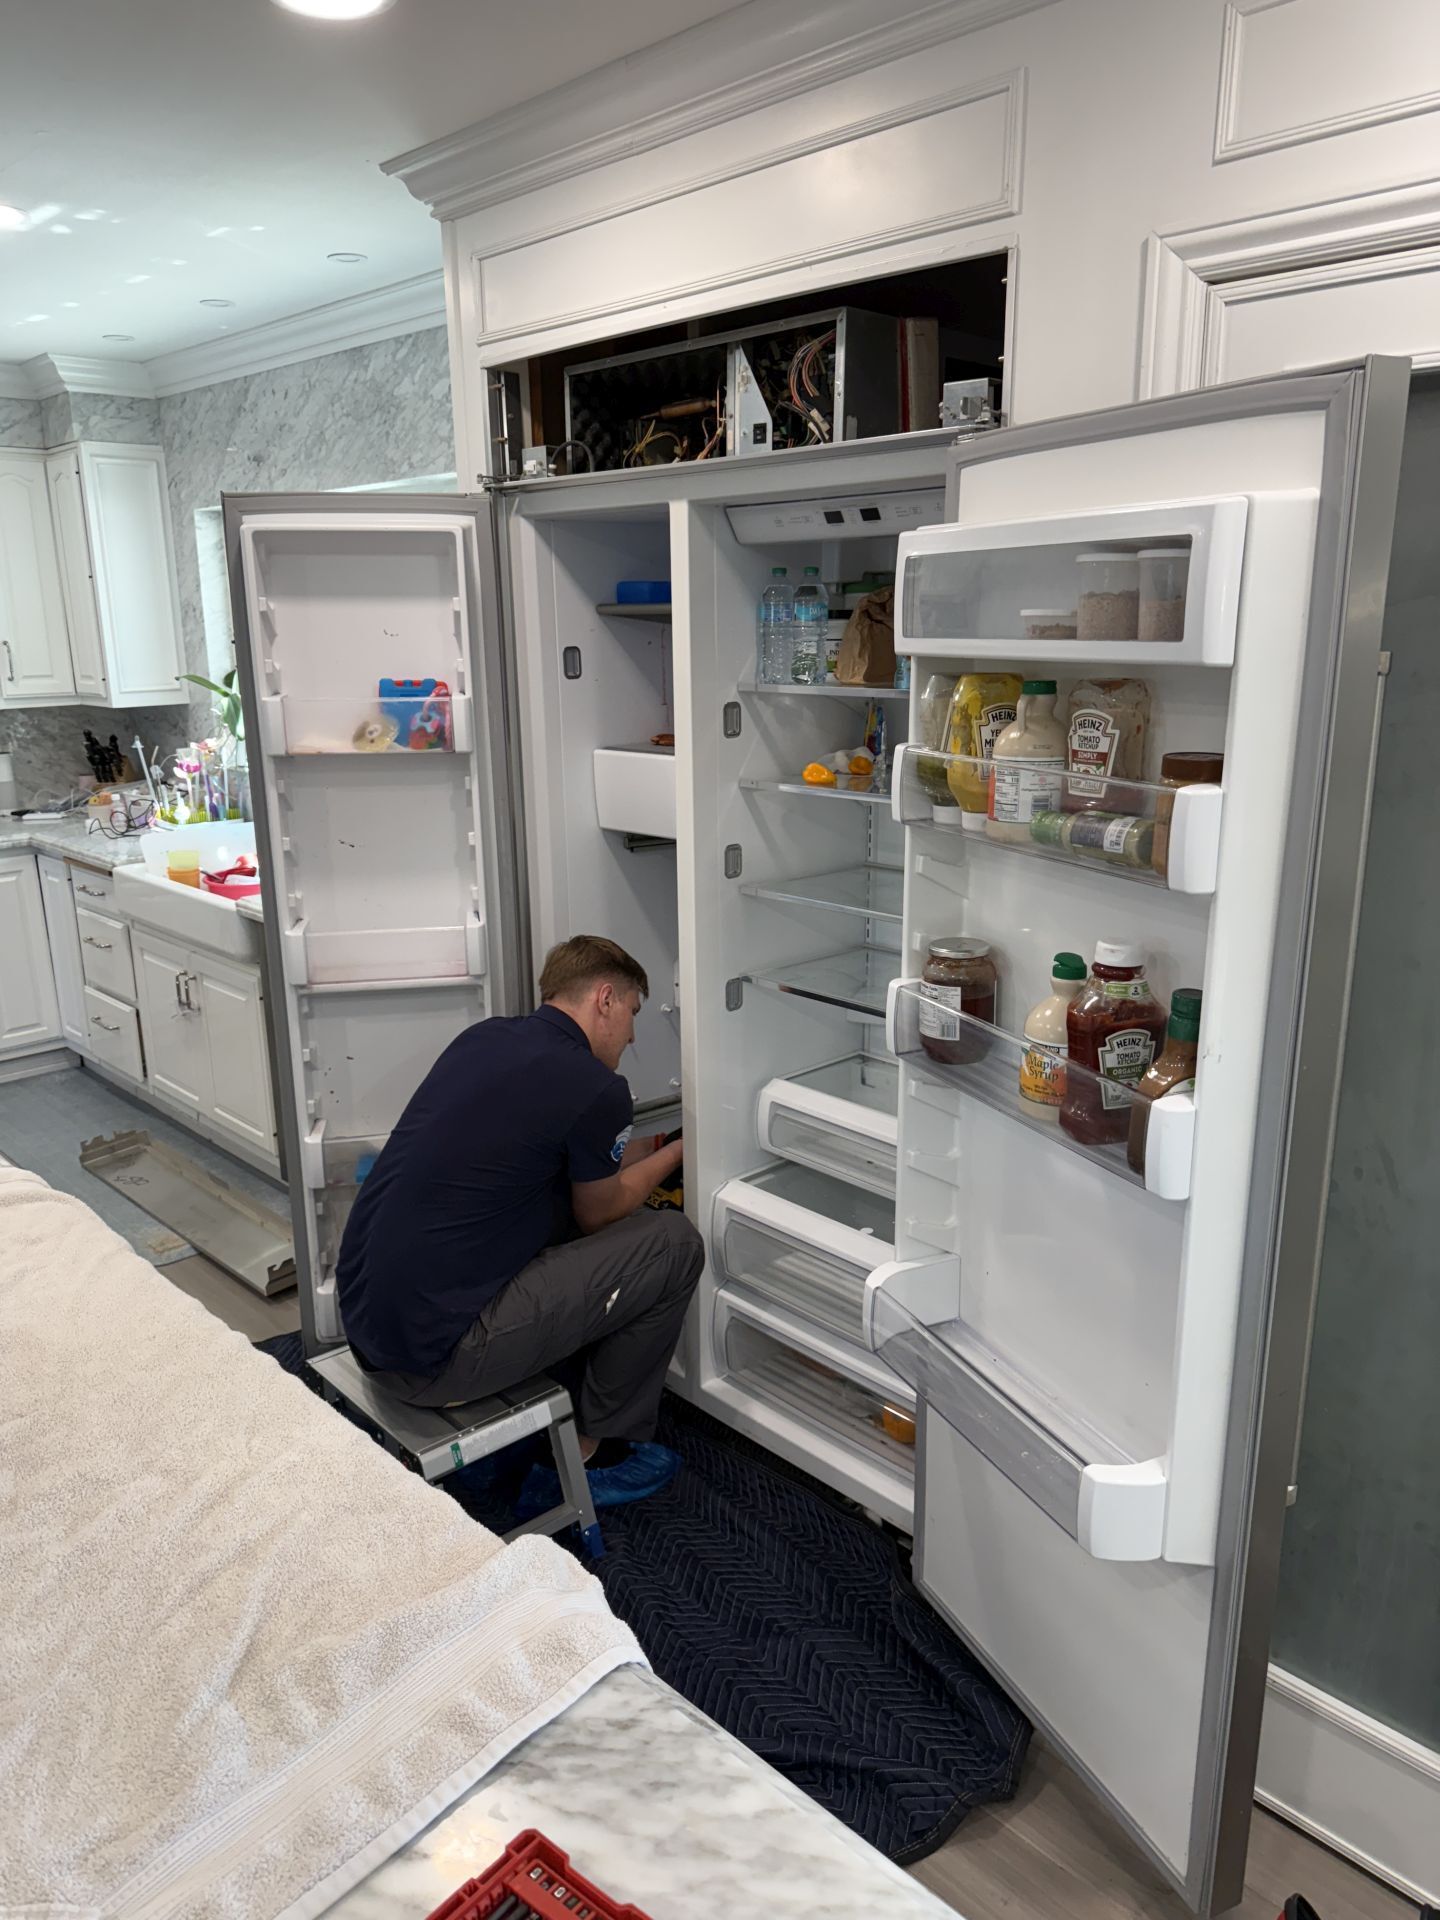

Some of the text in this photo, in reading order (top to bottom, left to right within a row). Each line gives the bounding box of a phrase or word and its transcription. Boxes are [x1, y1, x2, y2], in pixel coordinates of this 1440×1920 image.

[1077, 718, 1103, 731] HEINZ
[1077, 734, 1100, 744] TOMATO
[1078, 742, 1100, 750] KETCHUP
[1077, 751, 1098, 759] SIMPLY
[1116, 1037, 1142, 1048] HEINZ
[1116, 1051, 1141, 1060] TOMATO
[1029, 1056, 1059, 1071] Maple
[1029, 1066, 1059, 1083] Syrup
[1112, 1066, 1143, 1076] ORGANIC
